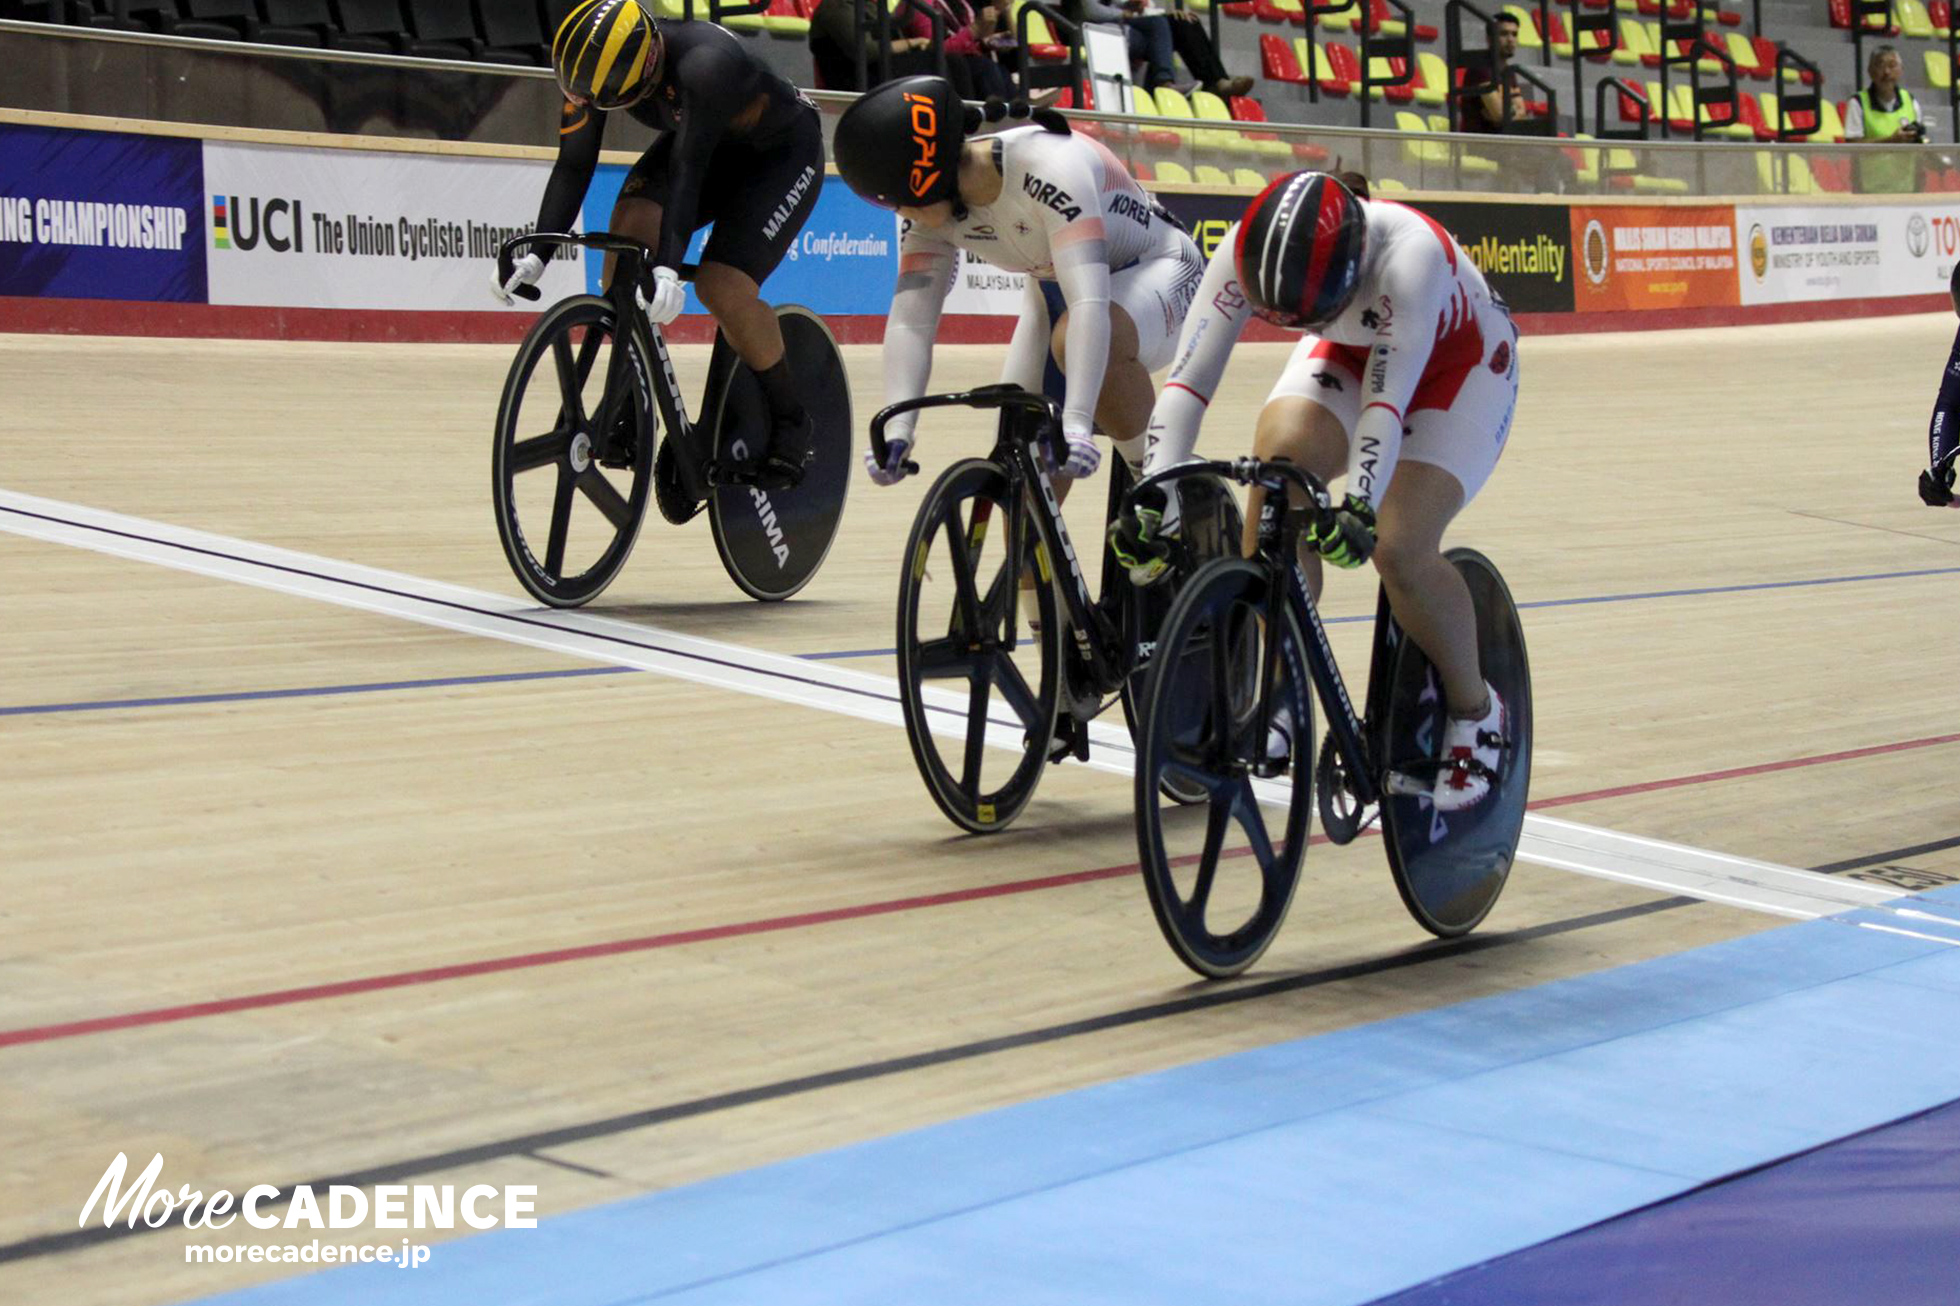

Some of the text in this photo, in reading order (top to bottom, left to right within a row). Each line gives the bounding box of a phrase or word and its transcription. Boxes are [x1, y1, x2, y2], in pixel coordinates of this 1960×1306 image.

[762, 165, 816, 241] MALAYSIA
[1022, 172, 1082, 223] KOREA
[1108, 193, 1151, 230] KOREA
[35, 198, 187, 250] CHAMPIONSHIP
[230, 196, 303, 253] UCI
[312, 213, 344, 255] The
[347, 215, 395, 256] Union
[398, 216, 464, 261] Cycliste
[803, 231, 888, 262] Confederation
[966, 275, 1011, 290] MALAYSIA
[652, 323, 693, 437] OOK
[1143, 415, 1165, 470] JAP
[1933, 411, 1945, 434] HONG
[732, 439, 790, 570] CRIMA
